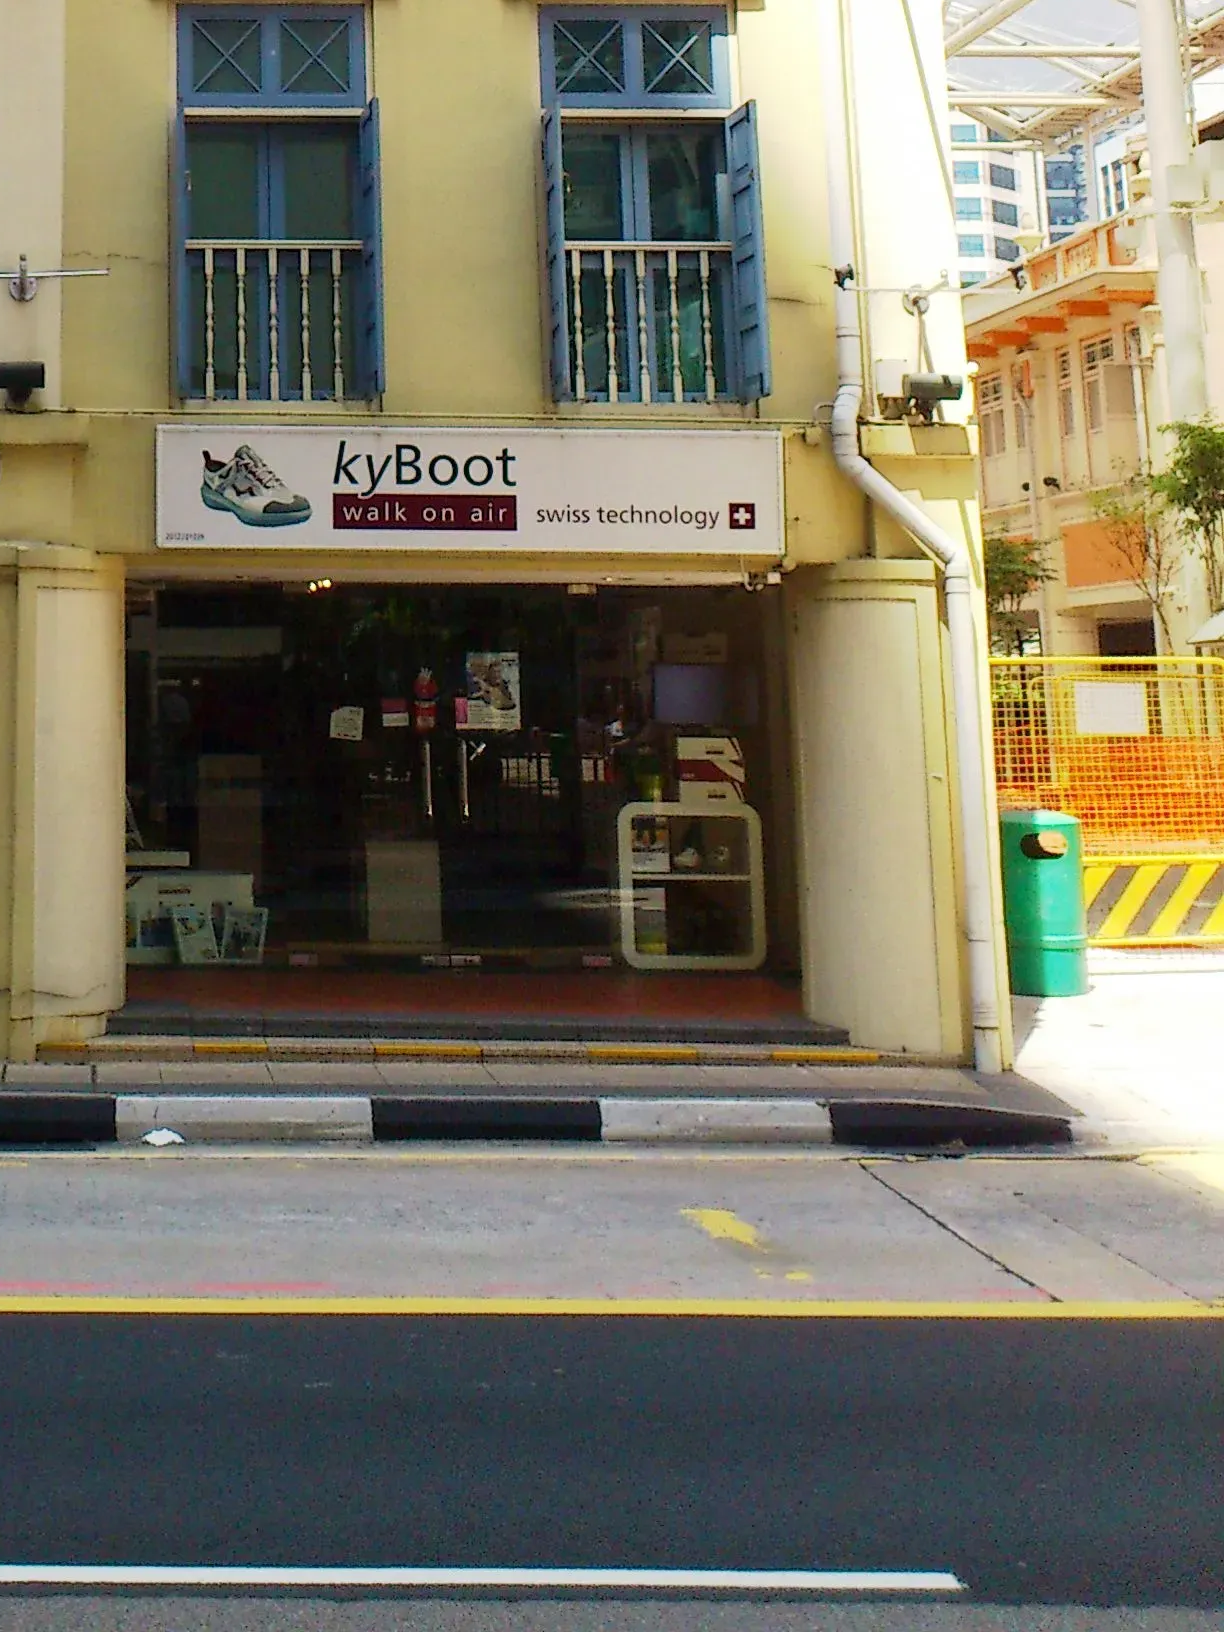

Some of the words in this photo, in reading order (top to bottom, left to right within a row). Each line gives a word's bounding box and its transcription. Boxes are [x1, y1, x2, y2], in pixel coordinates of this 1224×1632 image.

[333, 440, 517, 497] kyBoot
[342, 503, 407, 522] walk
[422, 505, 455, 522] on
[470, 501, 508, 523] air
[536, 504, 590, 524] swiss
[597, 504, 720, 529] technology
